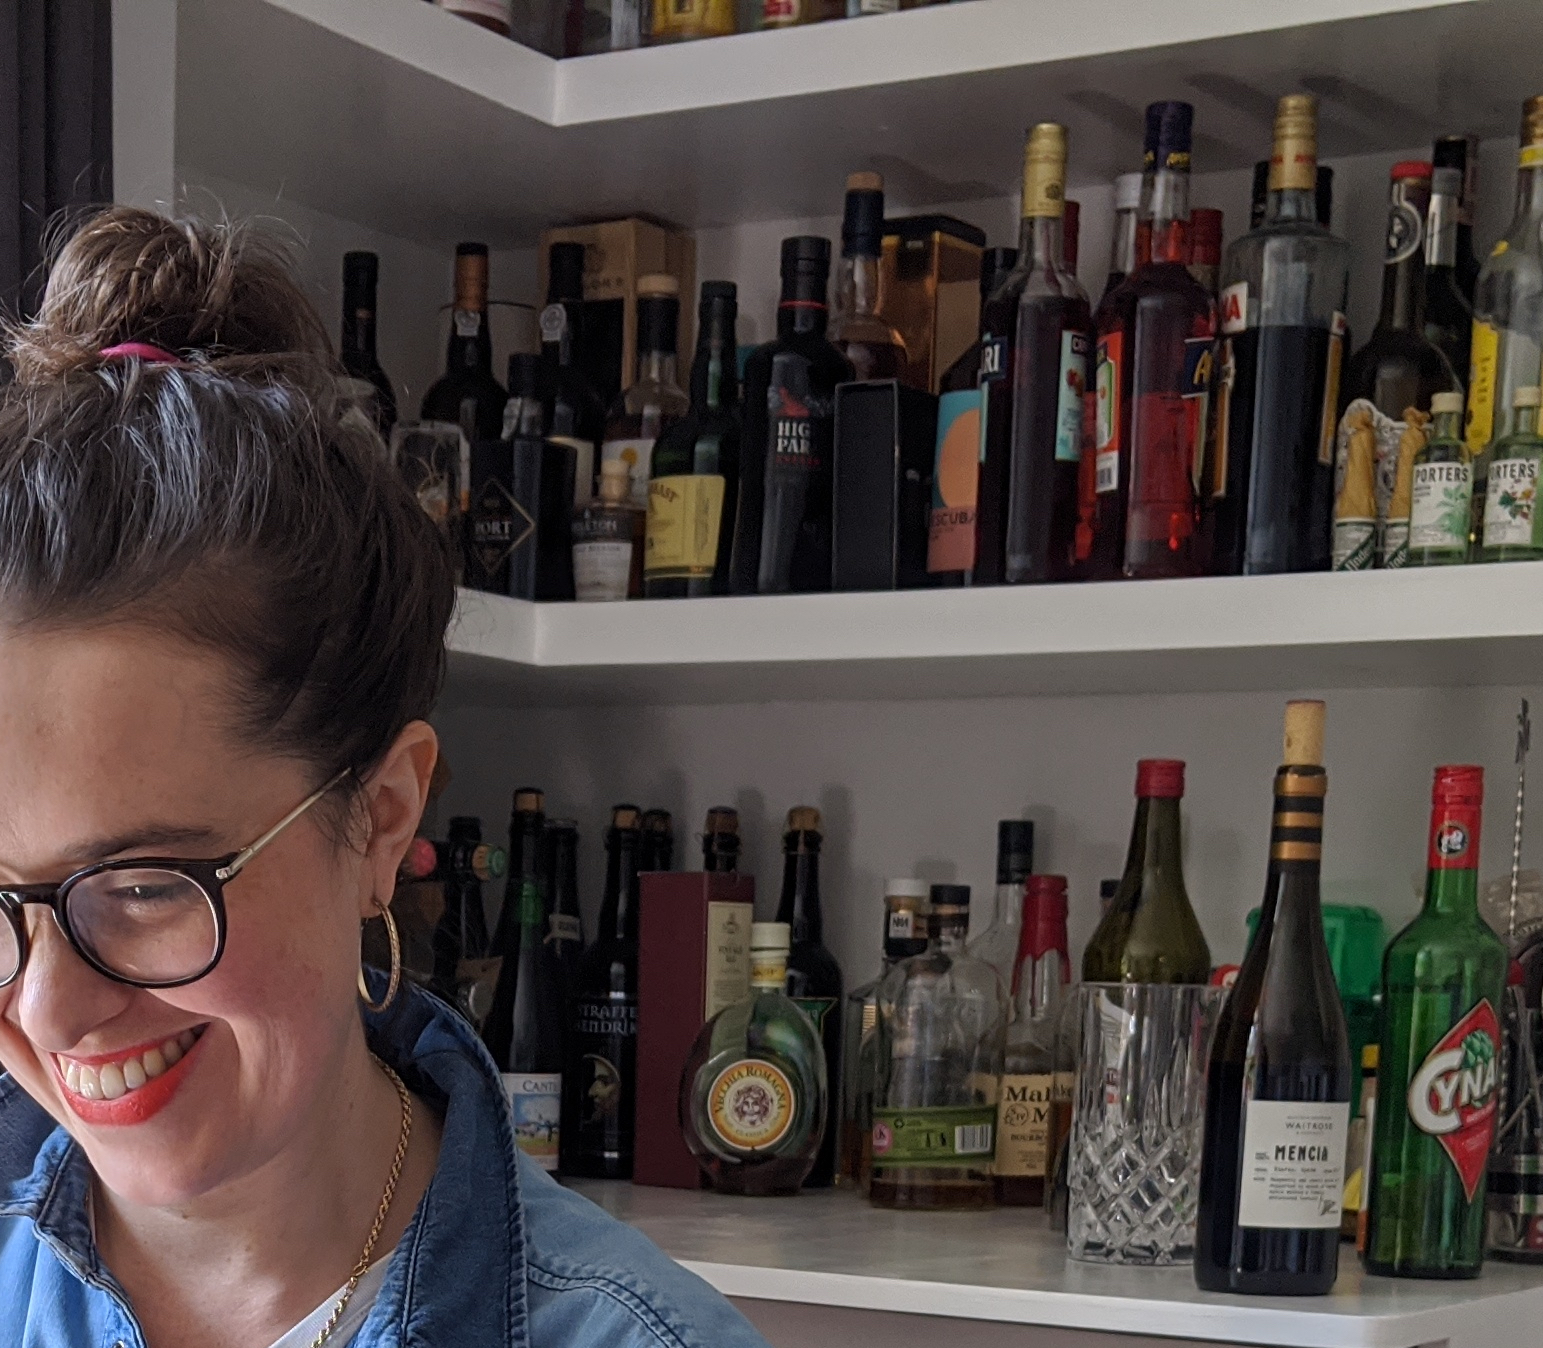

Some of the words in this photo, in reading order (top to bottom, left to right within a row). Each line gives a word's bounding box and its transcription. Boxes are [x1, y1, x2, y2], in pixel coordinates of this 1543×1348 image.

[1415, 466, 1470, 484] PORTERS
[714, 1070, 745, 1114] VECCHIA
[745, 1065, 786, 1110] ROMAGNA
[1285, 1122, 1333, 1131] WAITROSE
[1274, 1145, 1329, 1161] MENCIA
